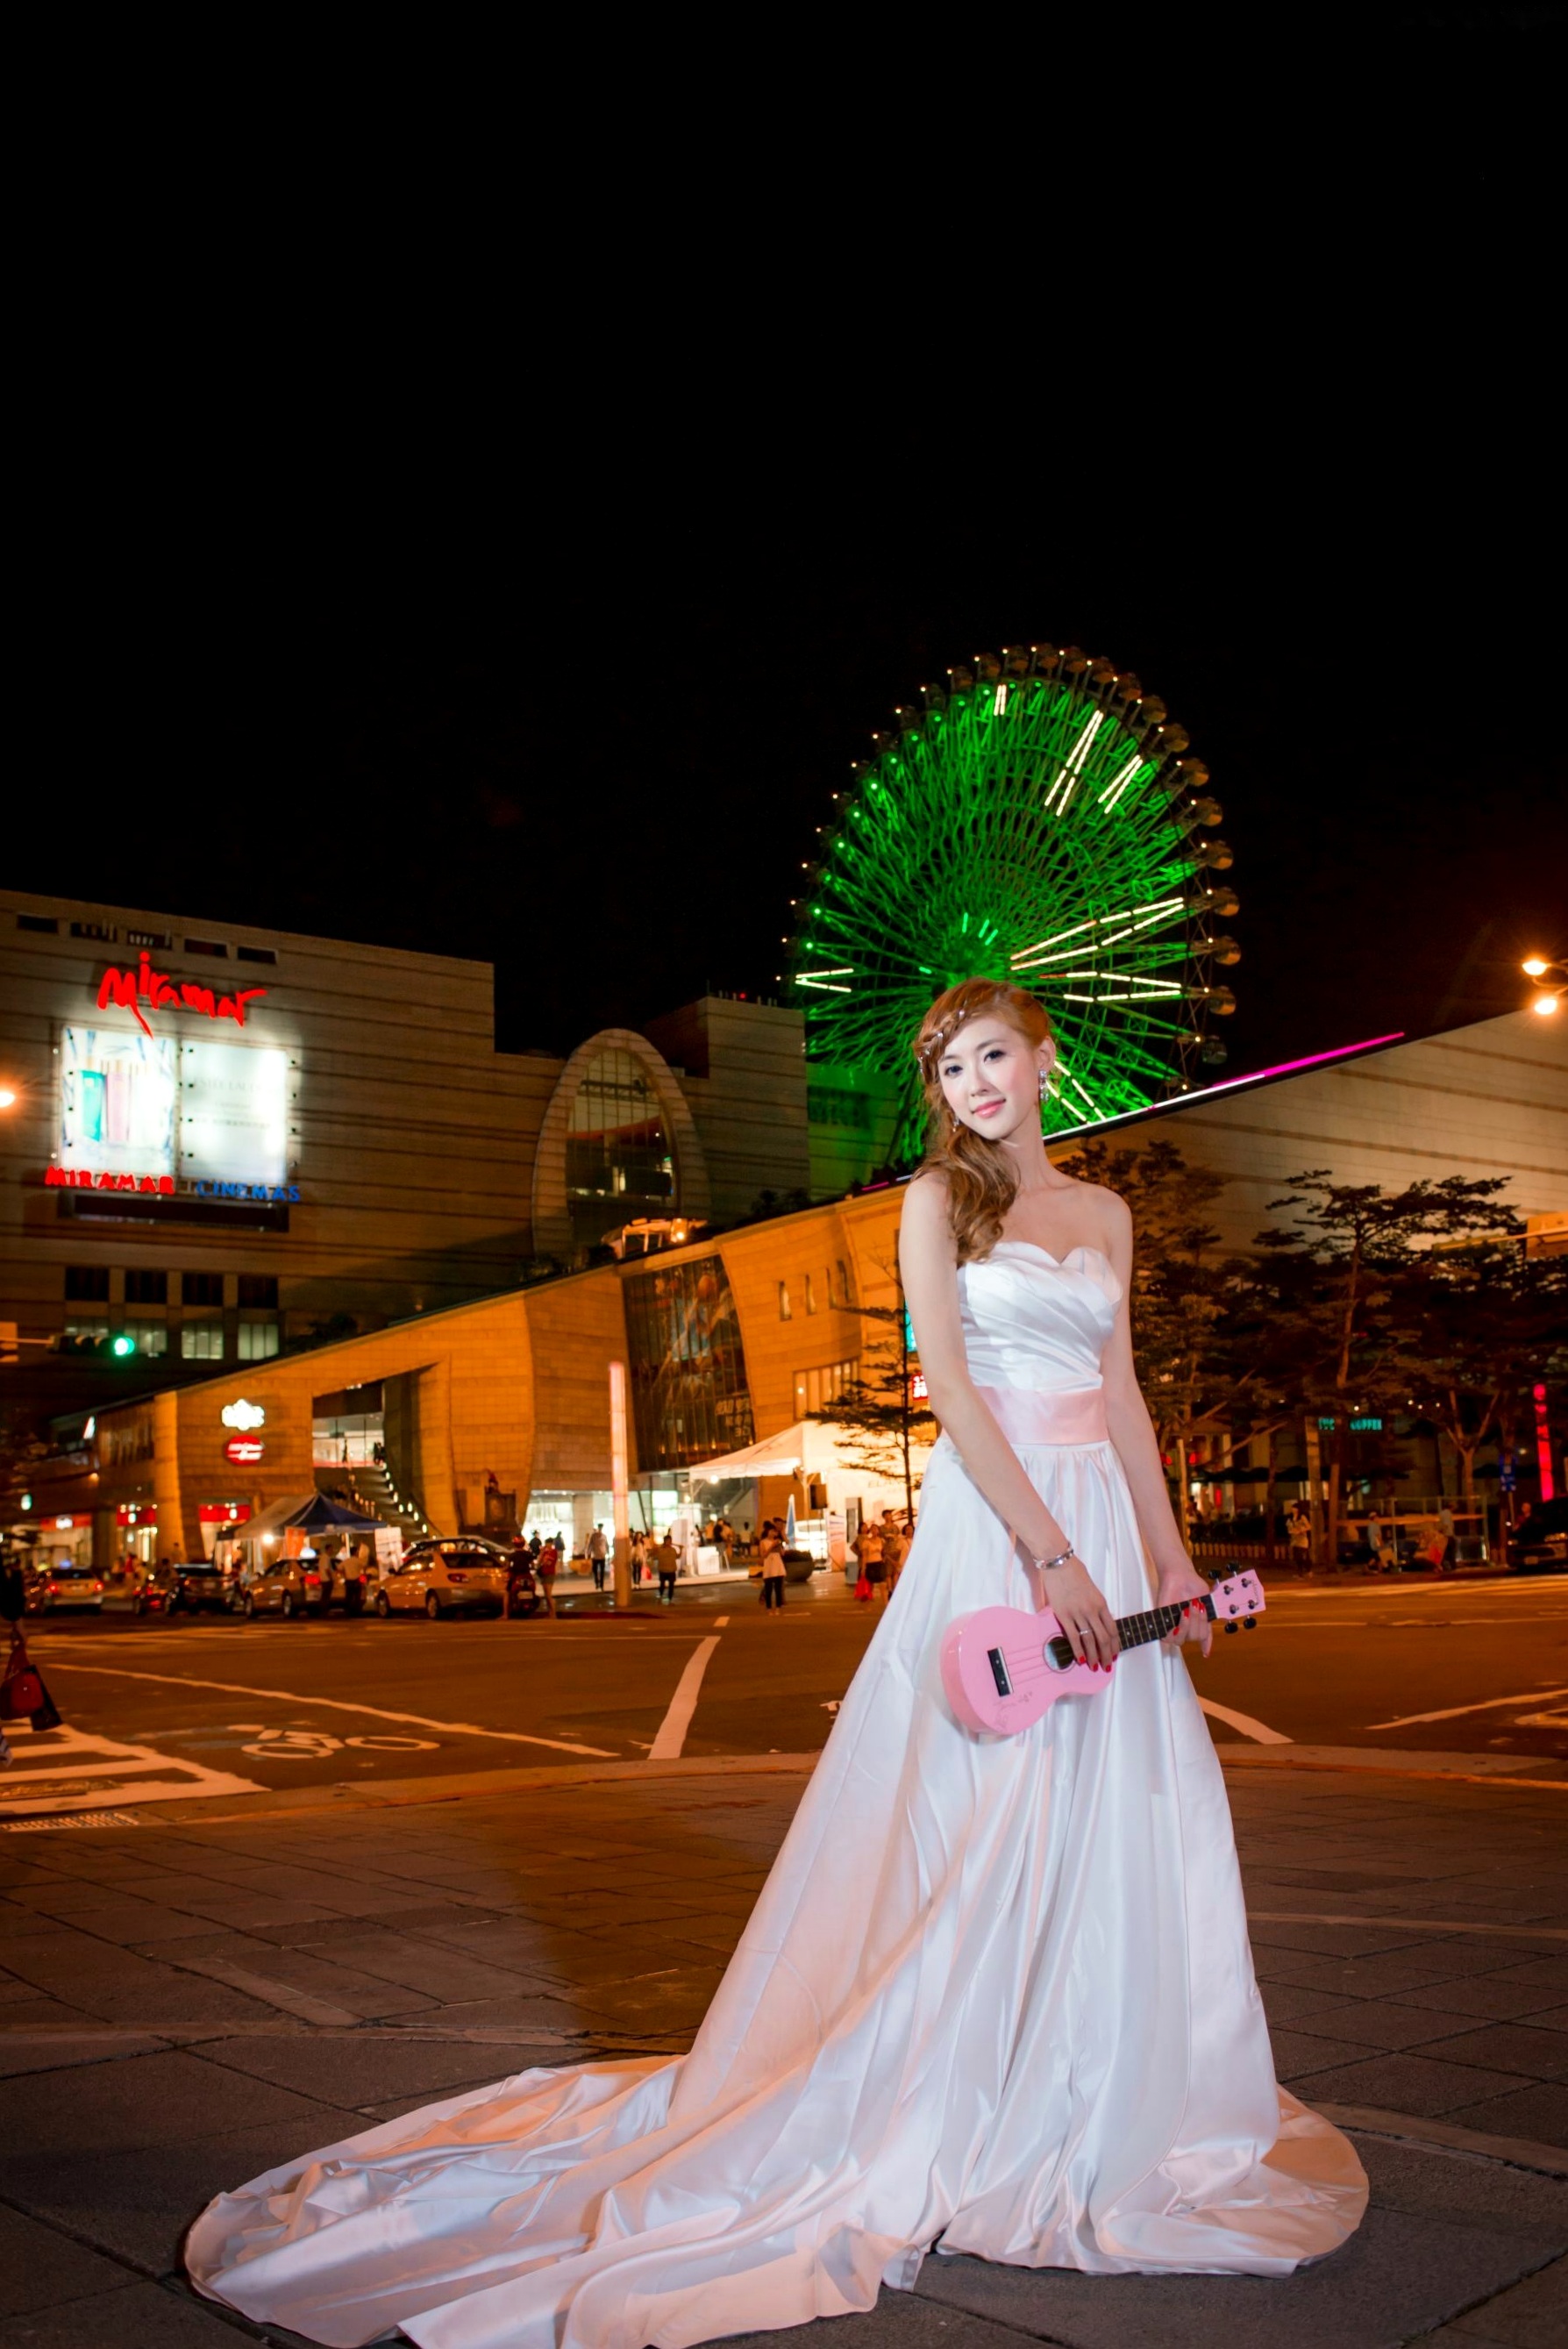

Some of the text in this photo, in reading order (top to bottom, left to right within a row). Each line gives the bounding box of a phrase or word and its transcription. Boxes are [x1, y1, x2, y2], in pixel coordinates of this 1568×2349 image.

[96, 952, 267, 1039] Miramar
[45, 1166, 301, 1203] MIRAMAR CINEMAS
